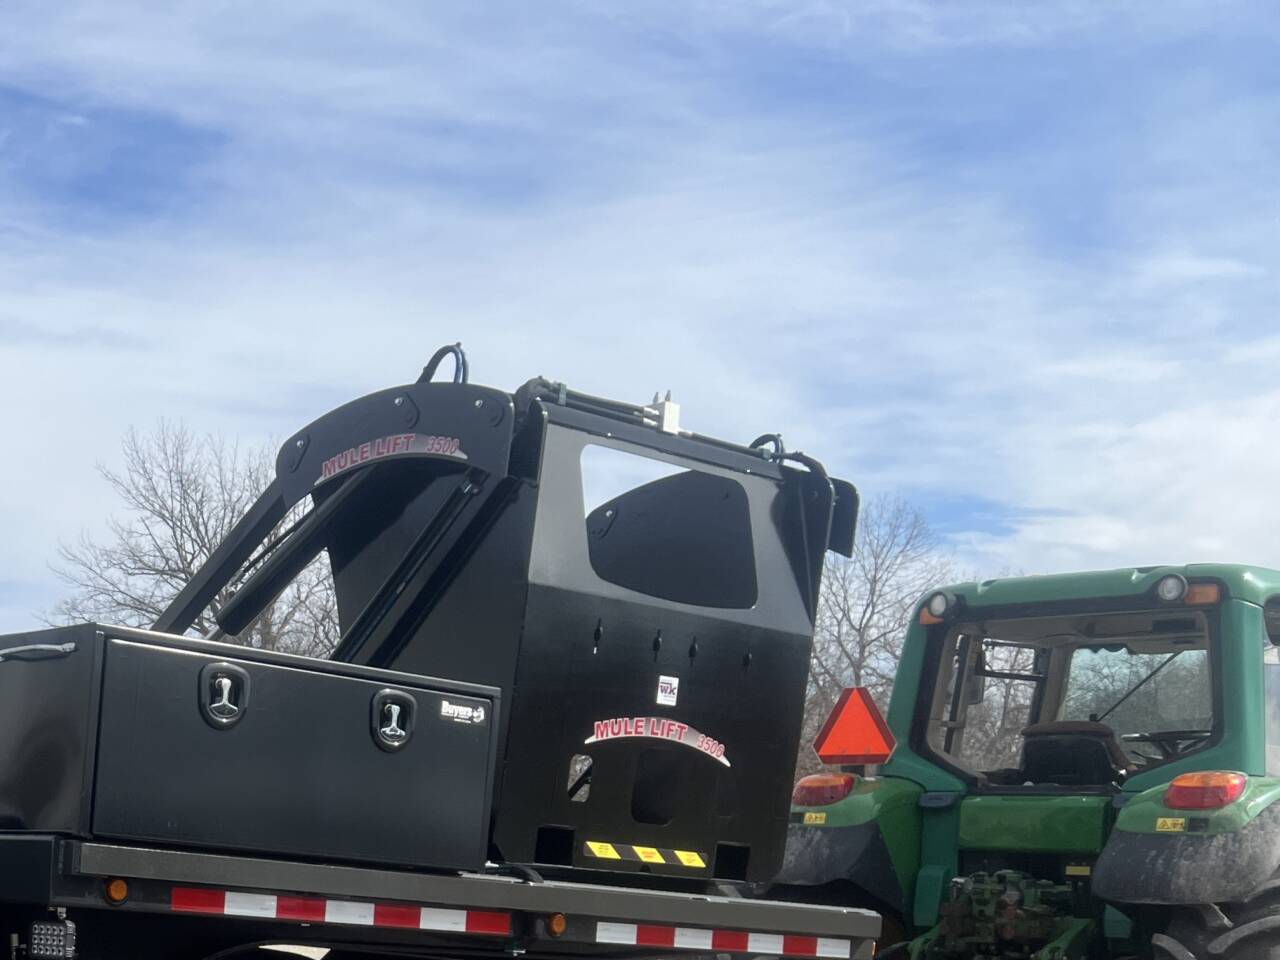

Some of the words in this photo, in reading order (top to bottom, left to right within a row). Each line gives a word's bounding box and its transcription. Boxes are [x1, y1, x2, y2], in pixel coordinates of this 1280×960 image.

[322, 441, 370, 478] MULE
[375, 433, 416, 457] LIFT
[441, 700, 472, 717] Buyers
[594, 718, 645, 739] MULE
[649, 718, 688, 741] LIFT
[696, 733, 725, 758] 3500
